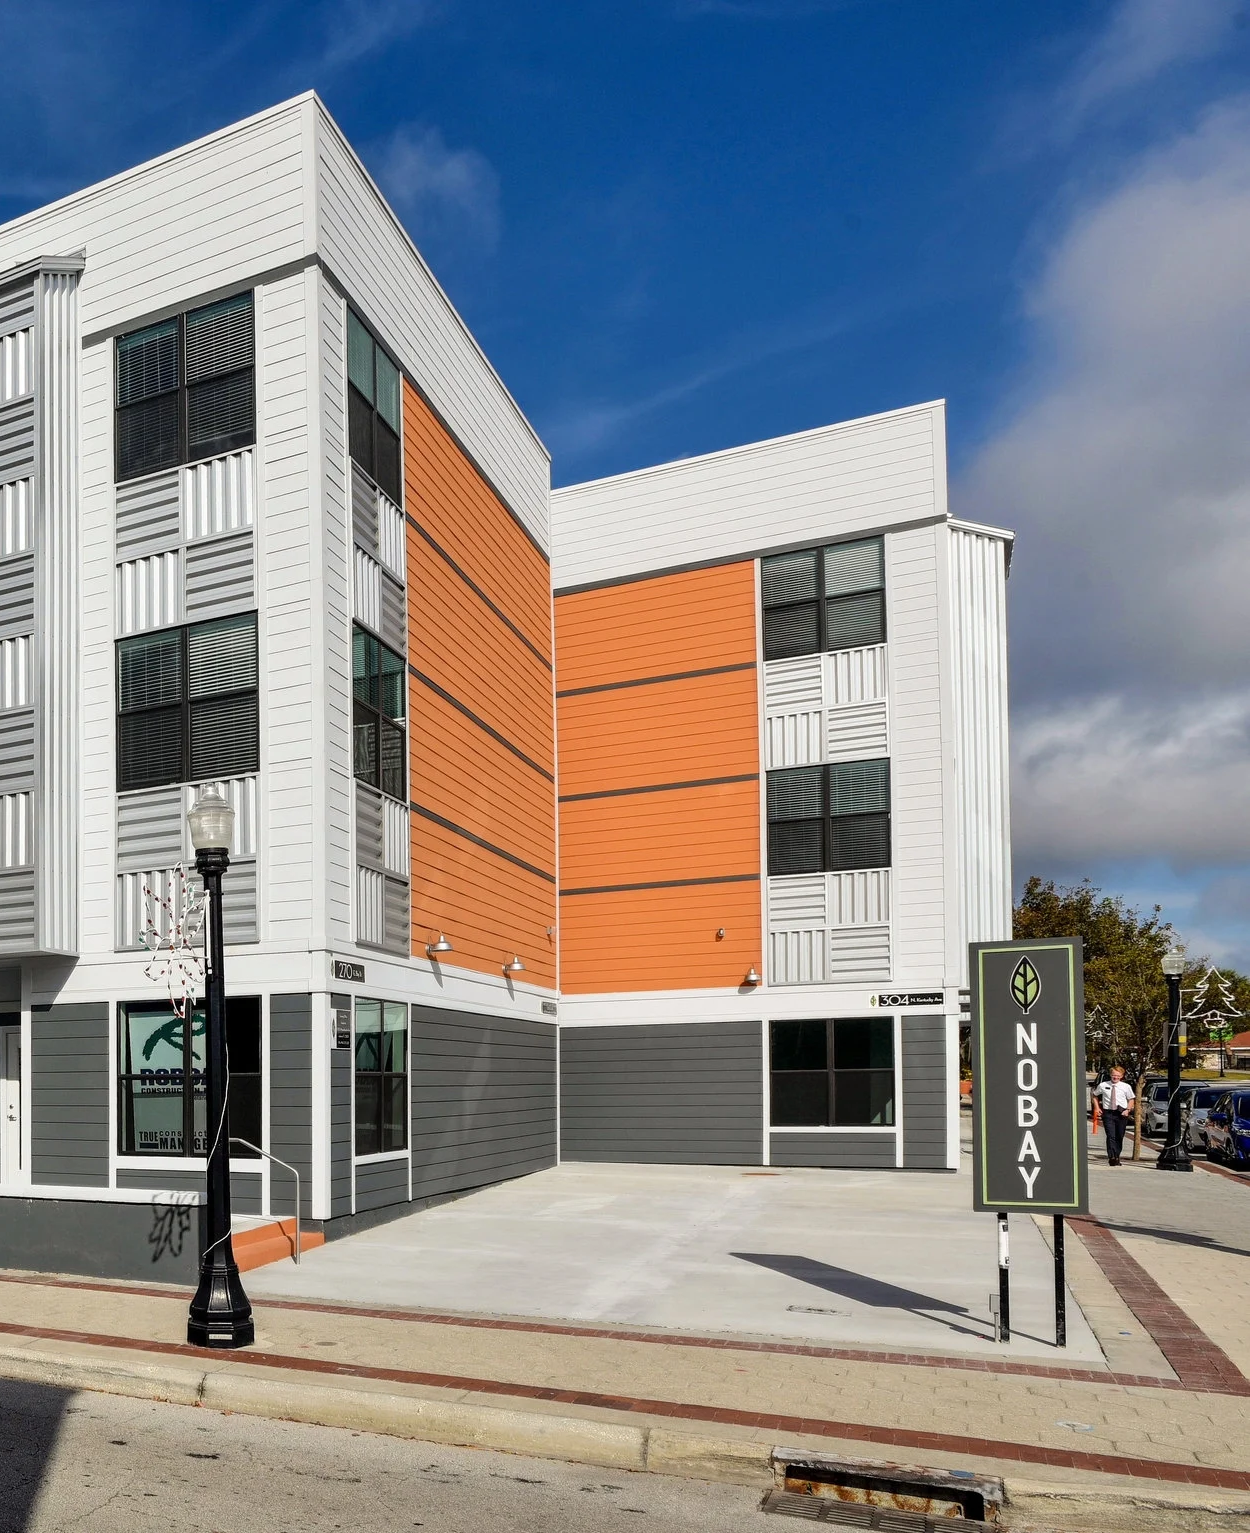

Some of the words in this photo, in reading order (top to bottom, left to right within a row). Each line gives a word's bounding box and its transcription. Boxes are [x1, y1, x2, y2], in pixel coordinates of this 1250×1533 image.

[339, 963, 353, 979] 270
[880, 995, 910, 1006] 304
[1016, 1022, 1041, 1199] NOBAY
[139, 1131, 158, 1142] TRUE
